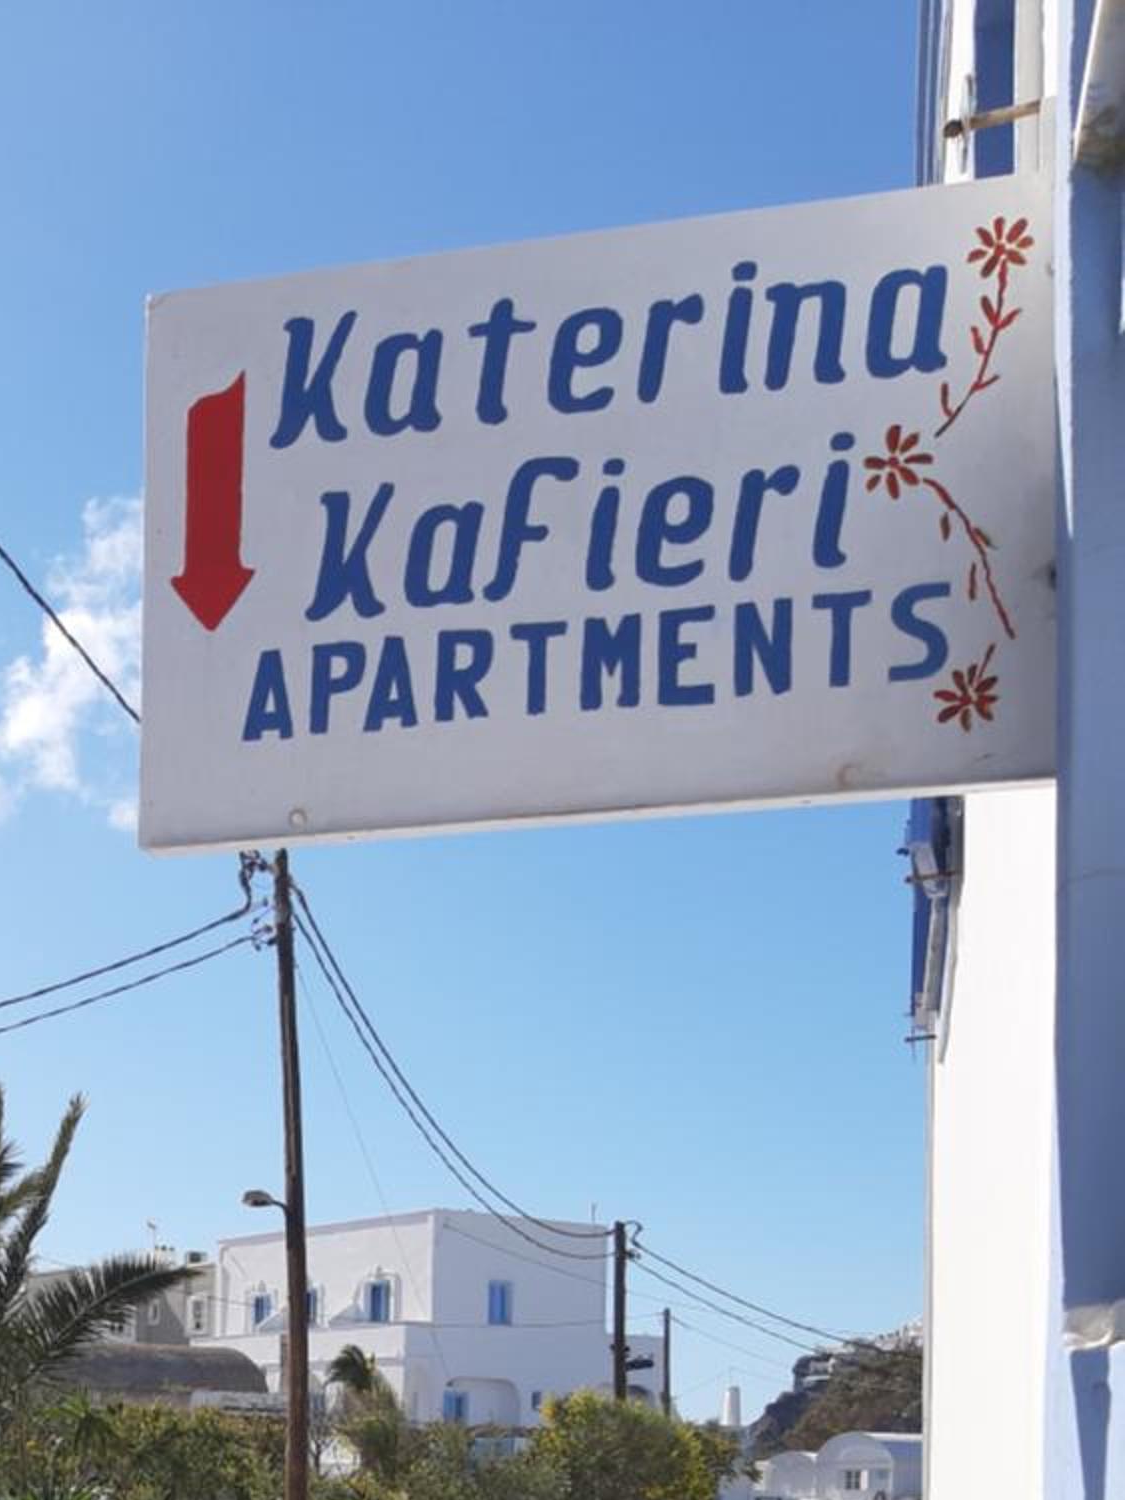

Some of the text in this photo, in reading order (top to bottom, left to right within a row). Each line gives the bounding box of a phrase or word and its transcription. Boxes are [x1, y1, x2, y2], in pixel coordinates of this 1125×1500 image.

[270, 261, 949, 450] Katerina
[305, 431, 855, 622] Kafieri
[242, 581, 951, 742] APARTMENTS
